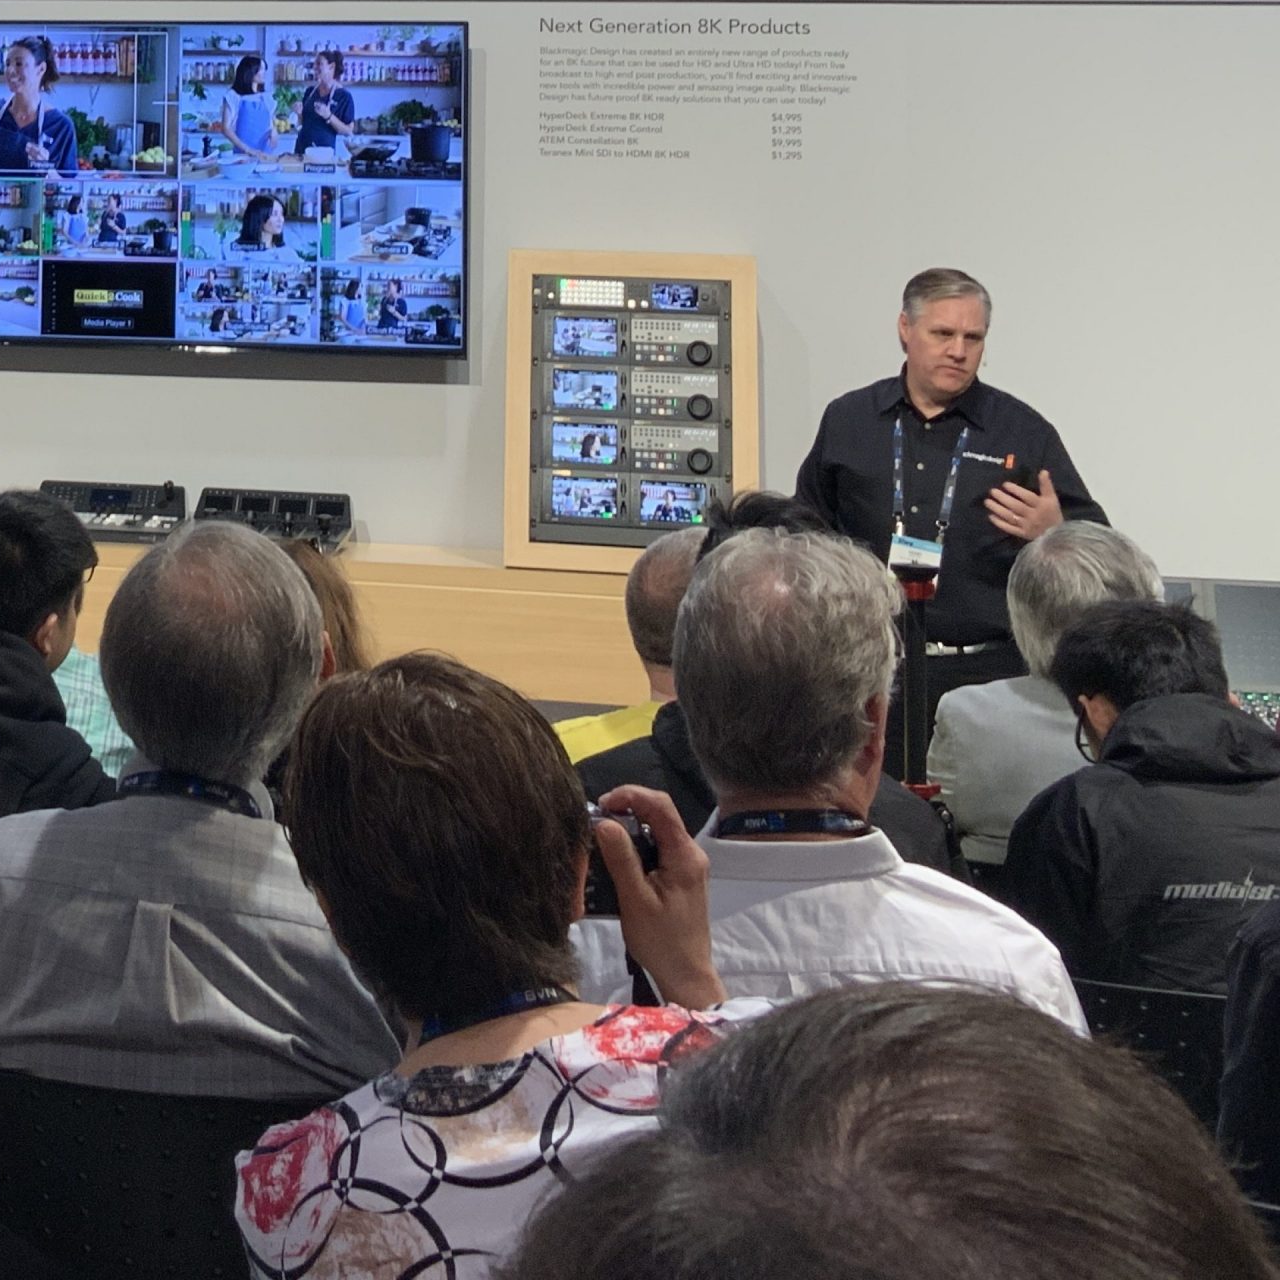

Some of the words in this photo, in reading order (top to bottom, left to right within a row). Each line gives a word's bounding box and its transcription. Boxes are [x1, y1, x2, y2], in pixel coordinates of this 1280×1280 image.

[540, 18, 582, 32] Next
[590, 18, 691, 33] Generation
[698, 19, 722, 34] 8K
[729, 19, 810, 34] Products
[539, 111, 588, 121] HyperDeck
[590, 111, 628, 120] Extreme
[643, 112, 664, 120] HDR
[539, 123, 588, 134] HyperDeck
[589, 124, 628, 133] Extreme
[629, 124, 663, 133] Control
[539, 135, 566, 144] ATEM
[567, 136, 625, 144] Constellation
[539, 148, 573, 156] Teranex
[574, 148, 594, 157] Mini
[595, 148, 612, 157] SDI
[613, 149, 624, 157] to
[625, 149, 653, 158] HDMI
[668, 149, 690, 158] HDR
[115, 291, 141, 302] Cook
[83, 318, 105, 327] Media
[105, 319, 126, 328] Player
